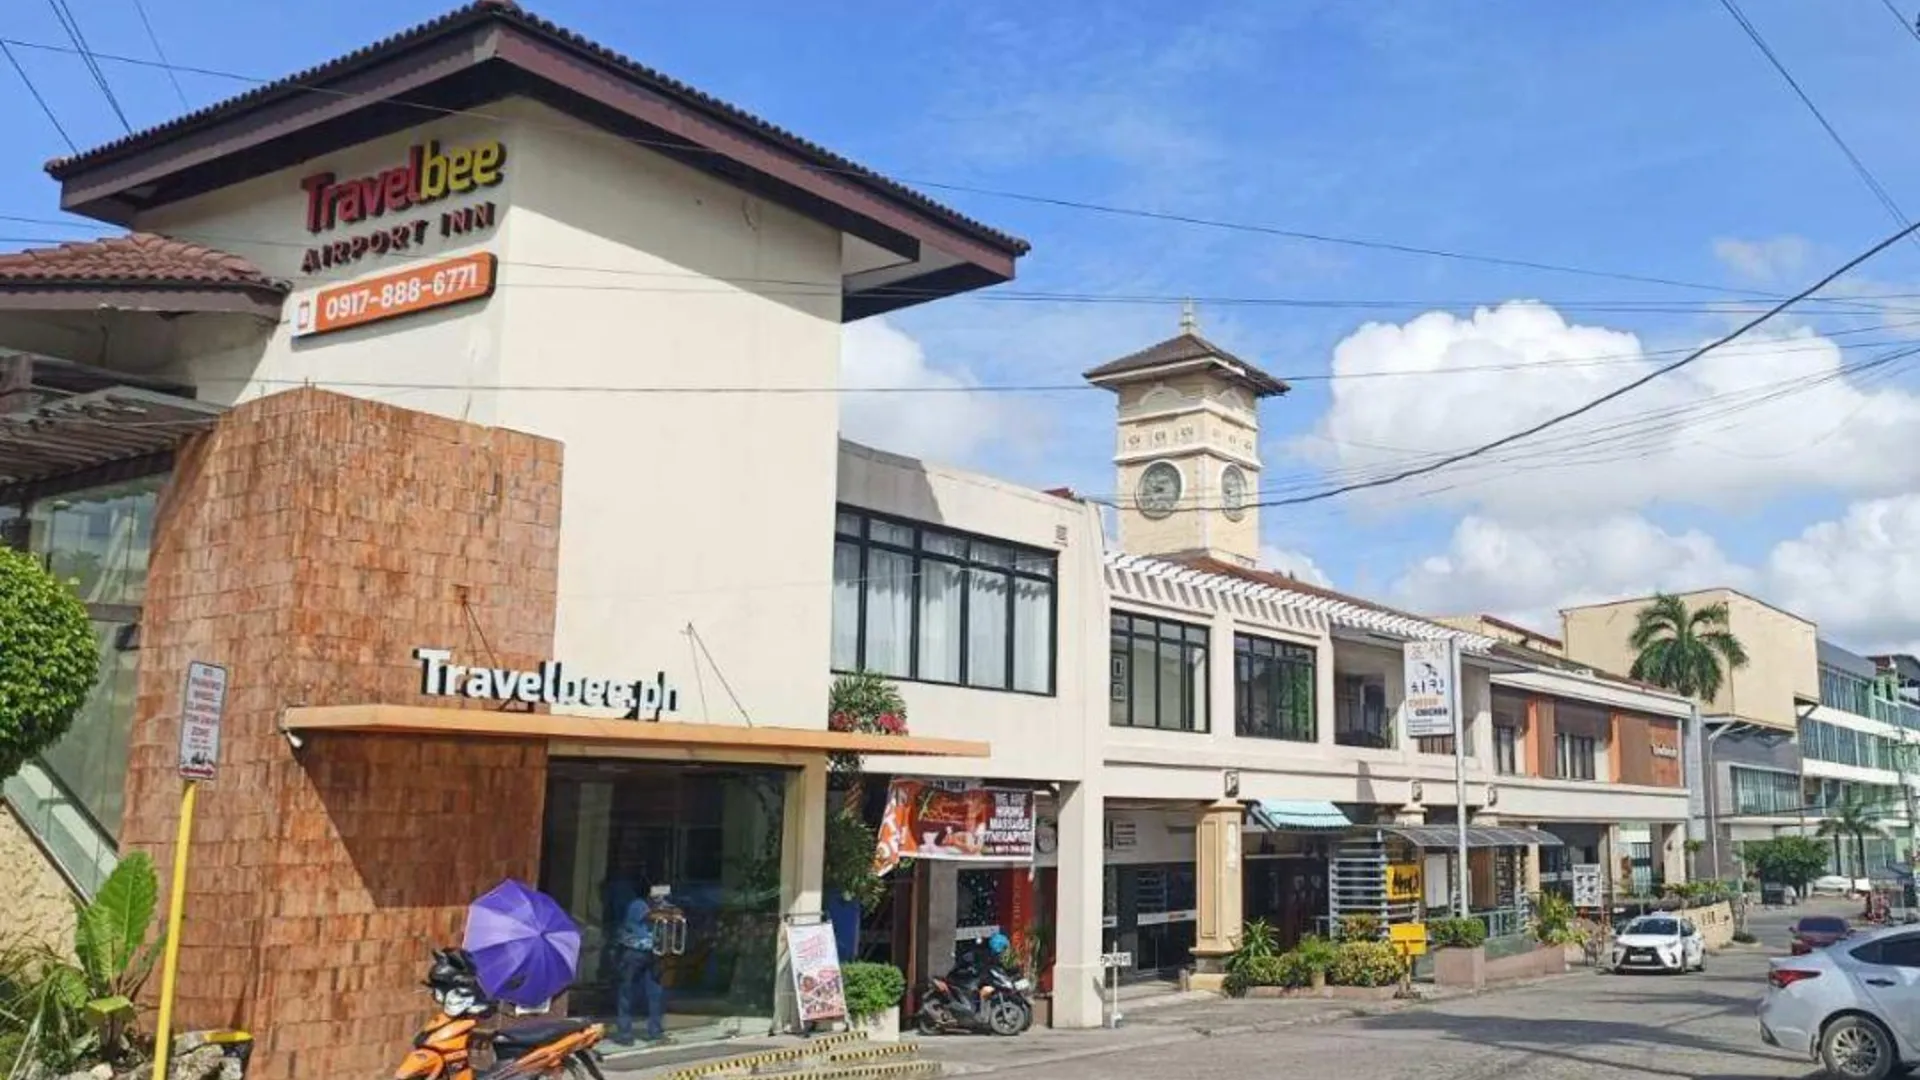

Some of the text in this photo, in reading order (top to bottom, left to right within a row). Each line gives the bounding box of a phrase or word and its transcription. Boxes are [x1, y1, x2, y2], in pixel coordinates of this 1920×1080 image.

[302, 140, 504, 233] Travelbee
[302, 201, 495, 273] AIRPORT INN
[325, 264, 477, 320] 0917-888-6771
